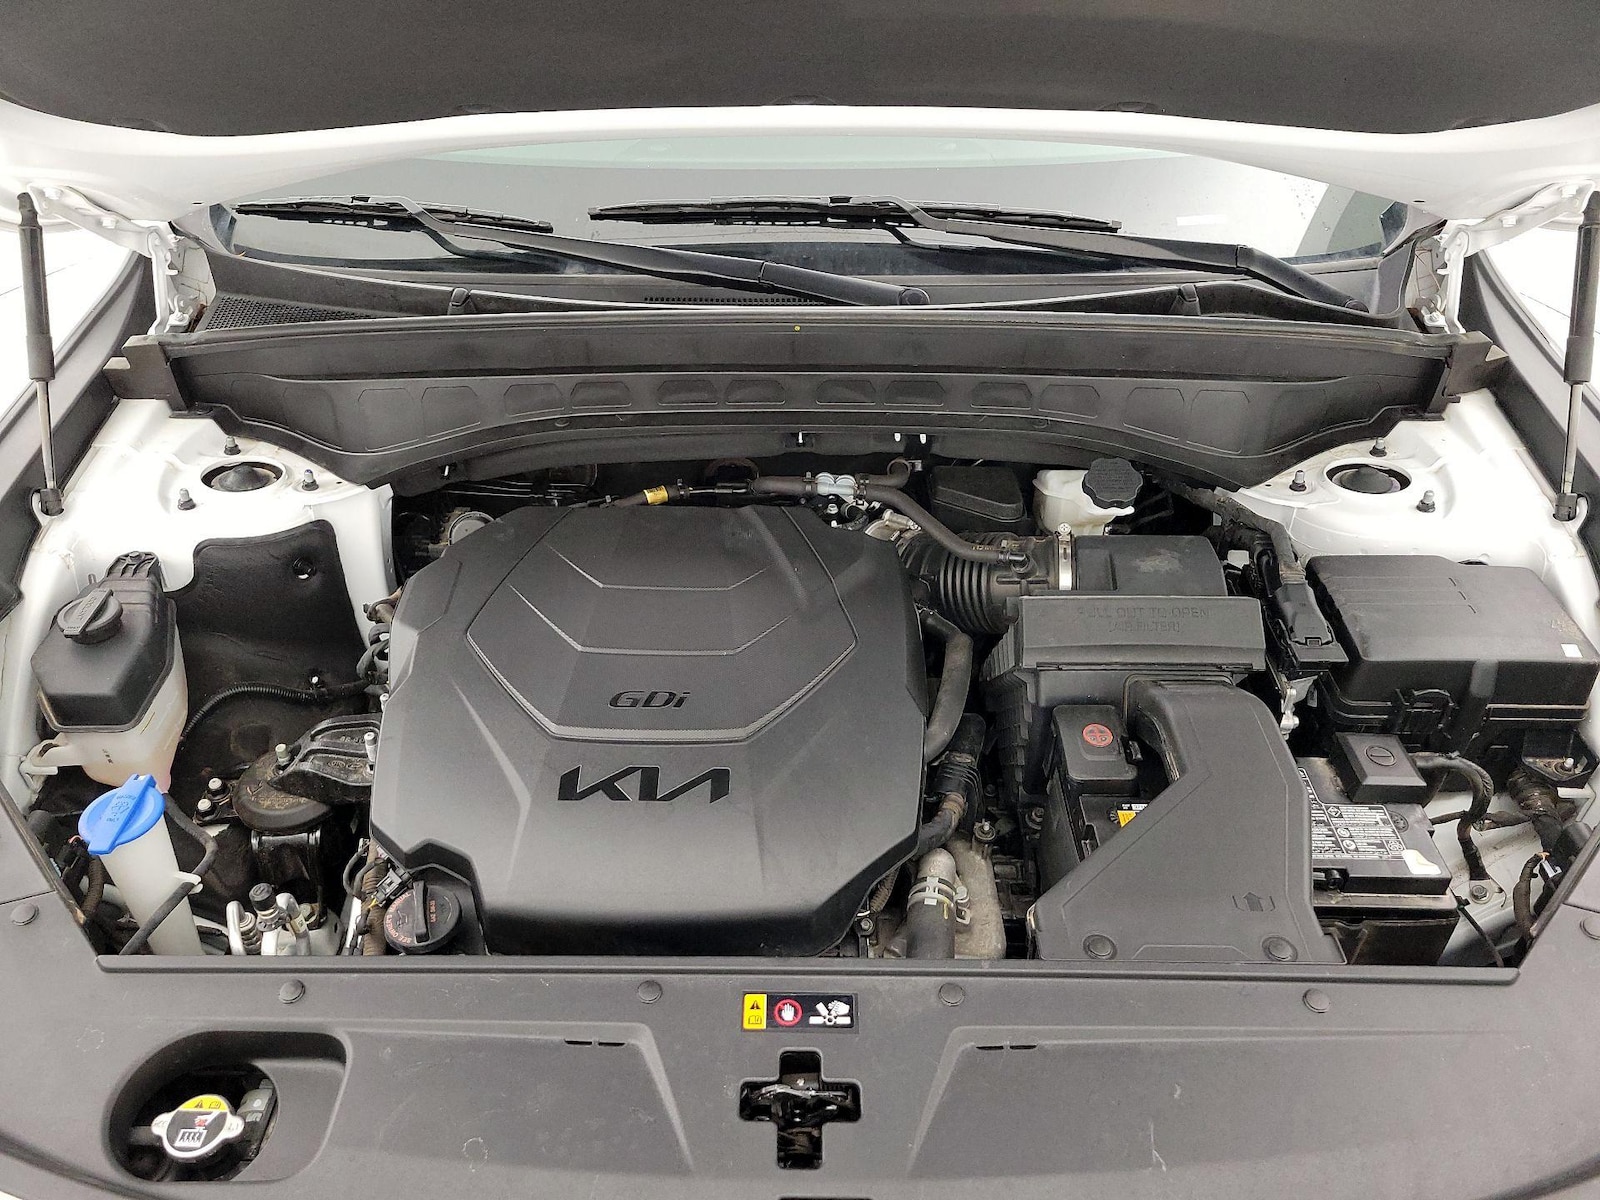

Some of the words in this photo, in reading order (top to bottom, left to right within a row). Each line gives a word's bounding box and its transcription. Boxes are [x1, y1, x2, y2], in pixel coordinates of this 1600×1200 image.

[1116, 607, 1145, 618] OUT
[1148, 607, 1167, 618] TO
[1171, 607, 1210, 618] OPEN
[608, 690, 691, 709] GDi
[558, 765, 731, 804] KIA
